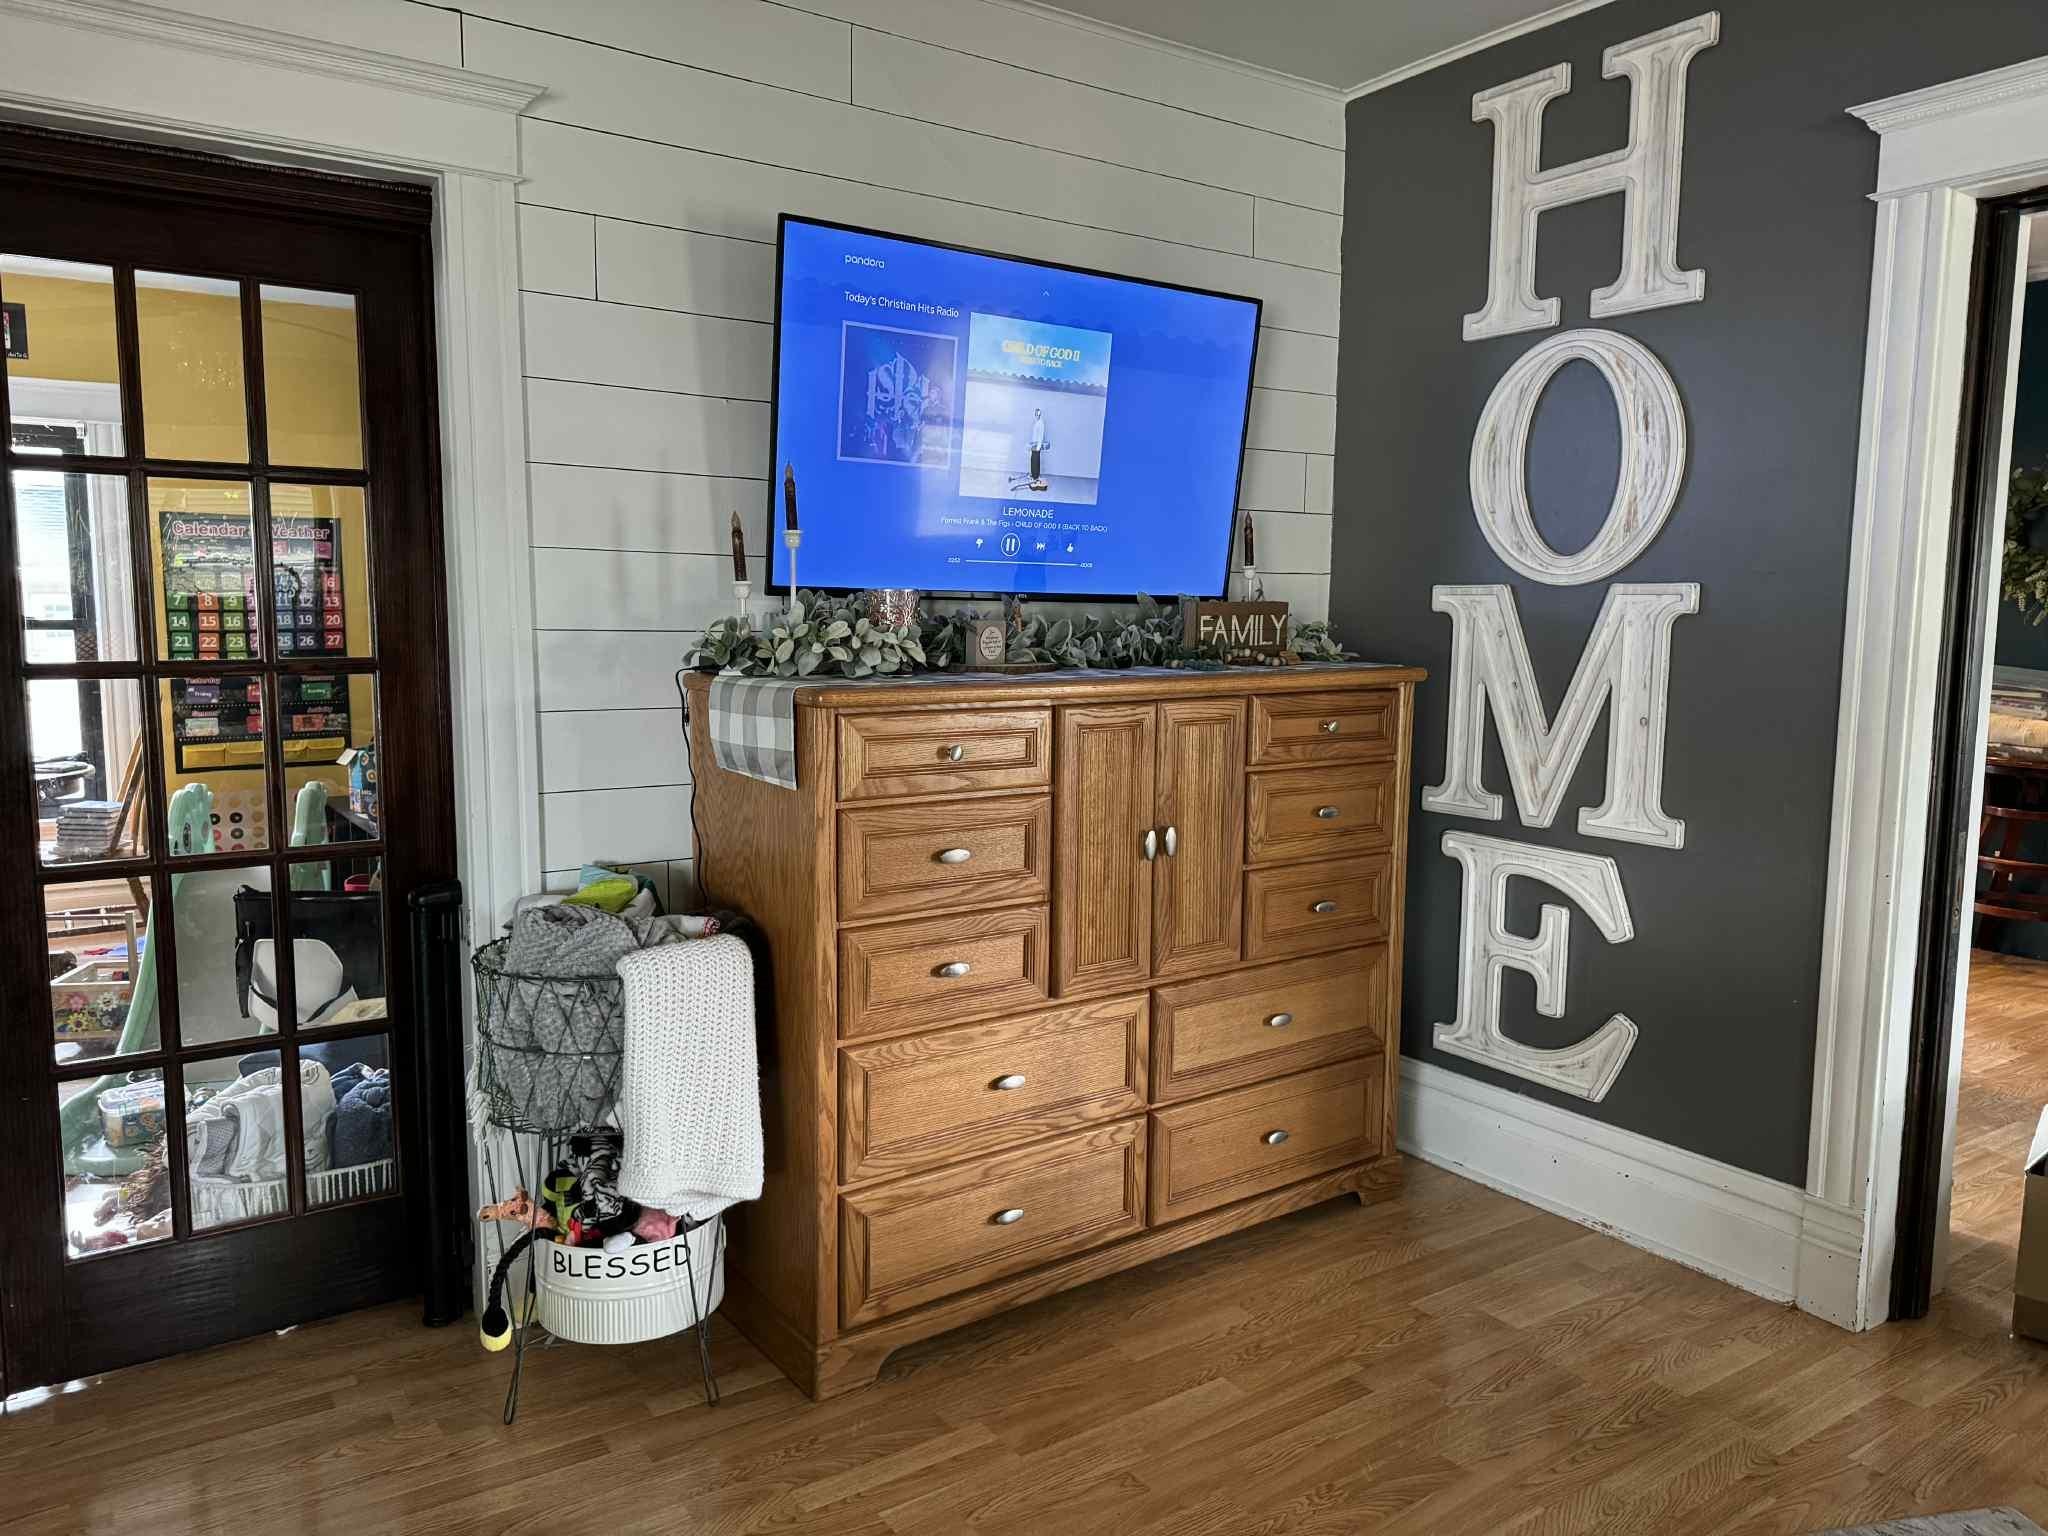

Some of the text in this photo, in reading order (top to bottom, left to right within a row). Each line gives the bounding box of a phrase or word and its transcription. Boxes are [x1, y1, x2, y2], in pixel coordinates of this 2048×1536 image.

[844, 254, 885, 269] pandora
[844, 290, 960, 318] Today's Christian Hits Radio
[1002, 506, 1055, 519] LEMONADE
[172, 520, 247, 538] Calendar
[1422, 10, 1720, 1103] HOME
[327, 577, 336, 588] 6
[173, 593, 182, 606] 7
[204, 592, 213, 607] 8
[326, 596, 340, 608] 13
[171, 615, 188, 628] 14
[201, 615, 217, 627] 15
[225, 615, 241, 628] 16
[276, 614, 291, 626] 18
[298, 614, 313, 625] 19
[326, 615, 341, 625] 20
[1200, 614, 1287, 647] FAMILY
[174, 636, 191, 648] 21
[201, 637, 217, 648] 22
[228, 635, 244, 648] 23
[277, 635, 291, 647] 25
[299, 635, 315, 647] 26
[327, 635, 341, 646] 27
[553, 1243, 692, 1280] BLESSED
